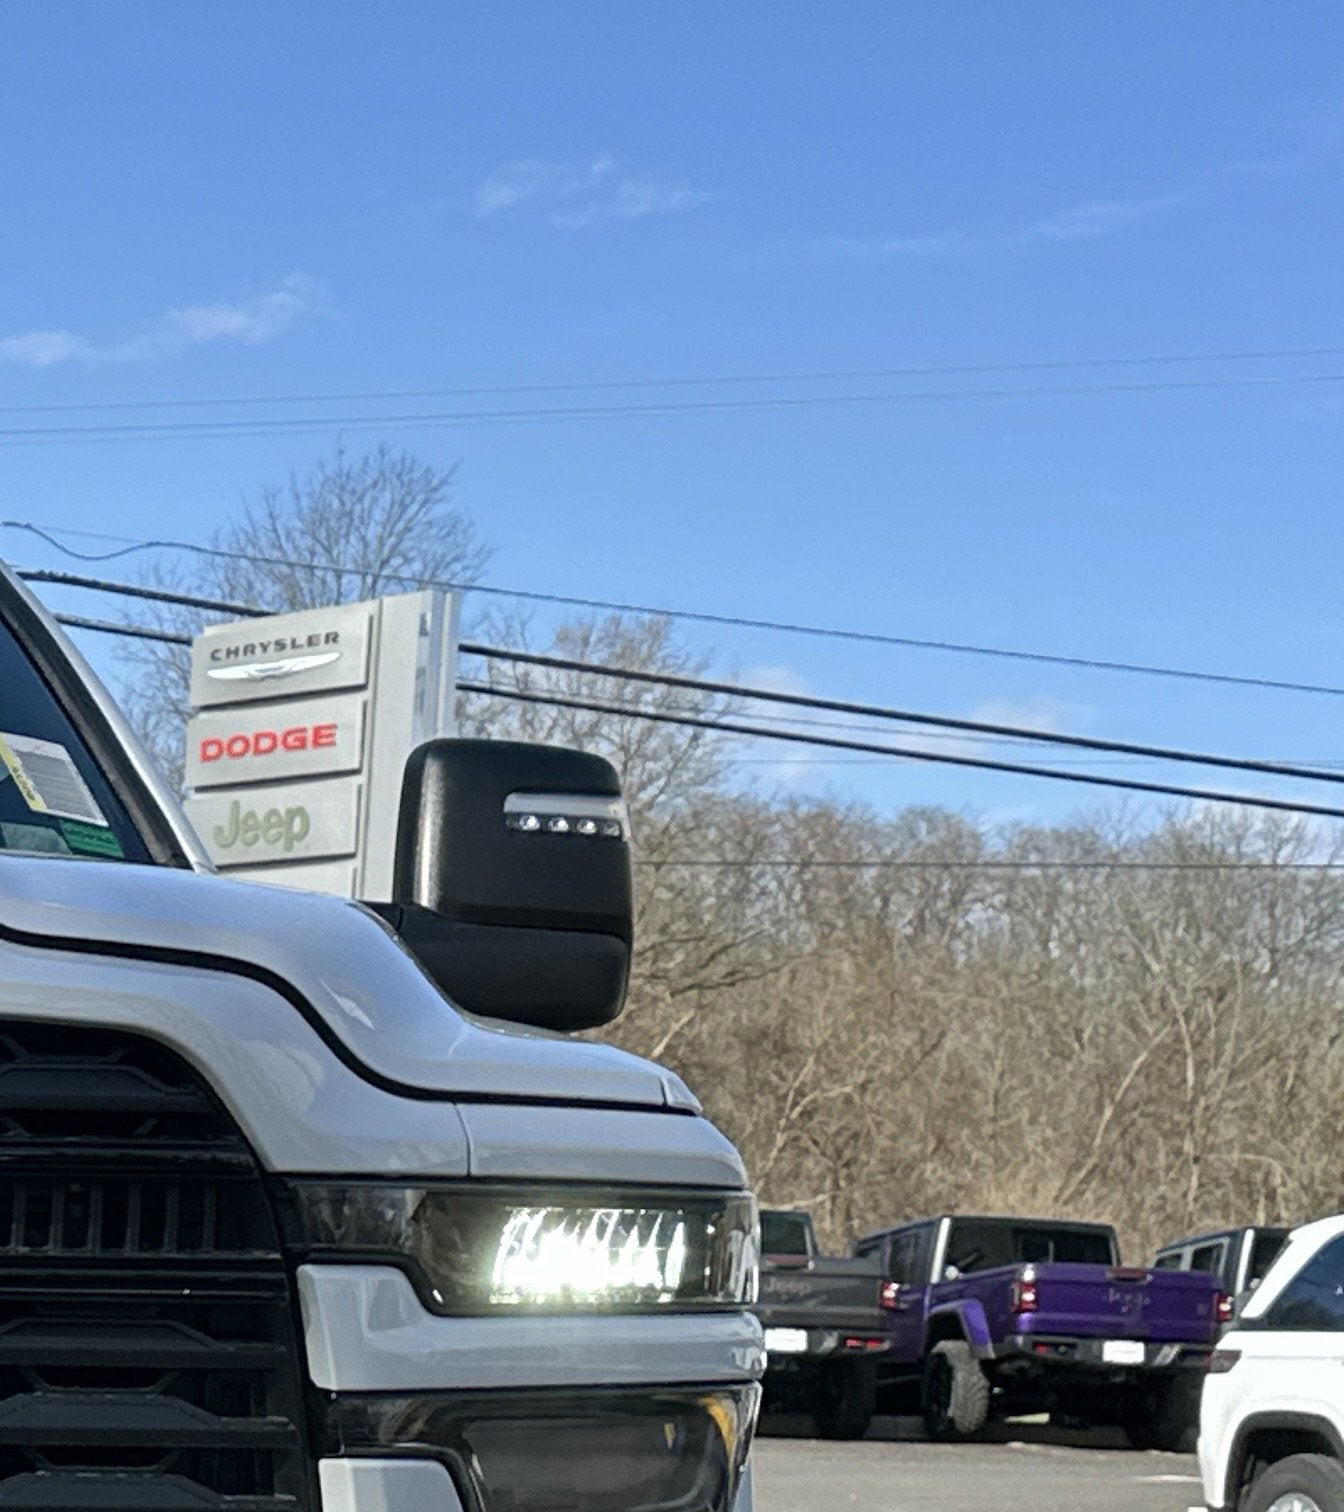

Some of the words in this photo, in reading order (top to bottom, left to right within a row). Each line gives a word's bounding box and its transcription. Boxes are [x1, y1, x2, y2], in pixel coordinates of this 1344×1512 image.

[210, 631, 340, 662] CHRYSLER
[199, 723, 338, 763] DODGE
[214, 800, 310, 852] Jeep
